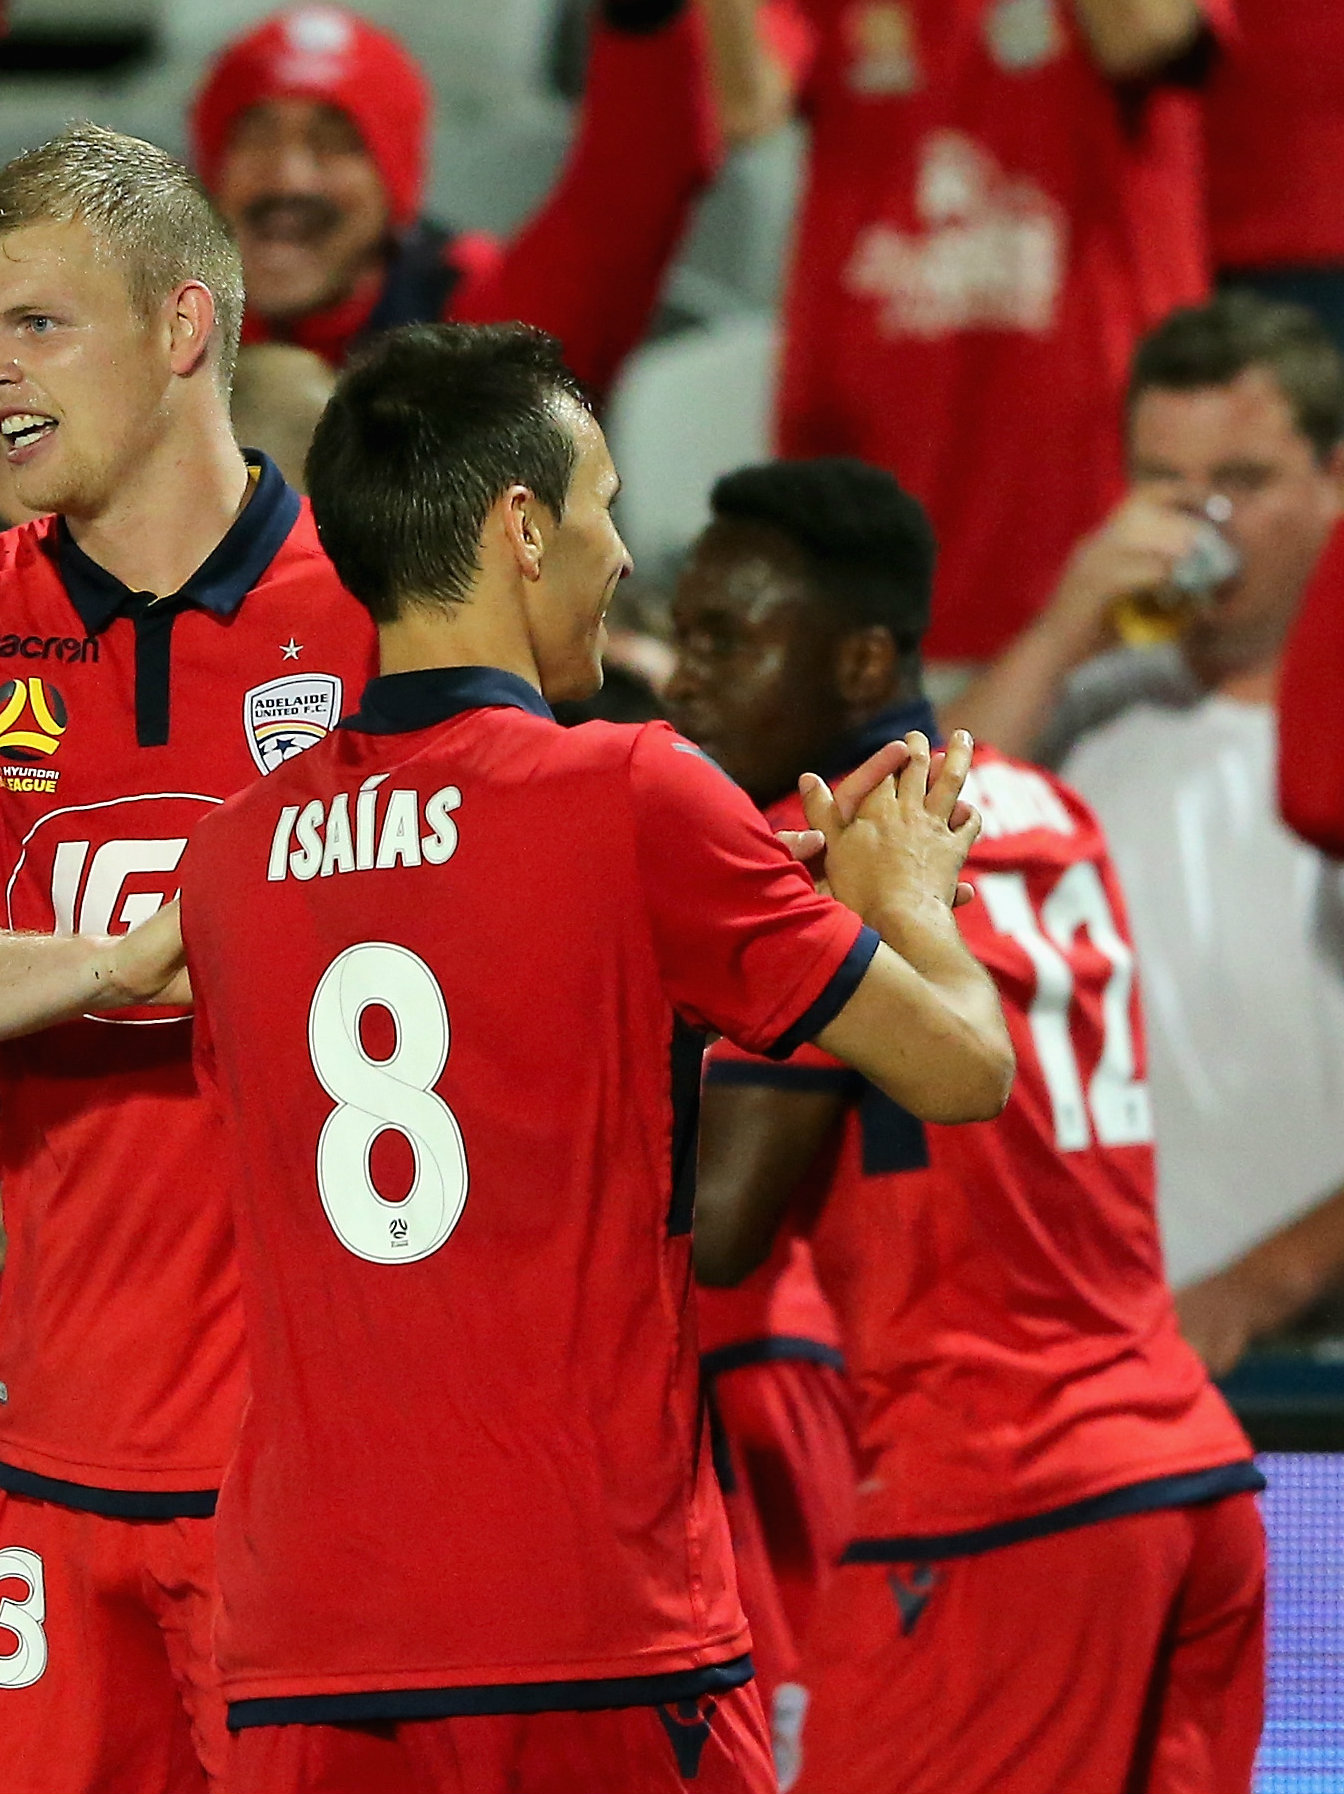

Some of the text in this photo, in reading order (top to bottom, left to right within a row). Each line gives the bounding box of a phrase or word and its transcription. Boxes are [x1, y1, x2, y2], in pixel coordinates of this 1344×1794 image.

[254, 693, 328, 709] ADELAIDE
[254, 704, 327, 718] UNITED F.C.
[3, 766, 60, 779] HYUNDAI
[267, 772, 462, 881] ISAÍAS
[52, 839, 188, 936] IG
[976, 860, 1154, 1151] 12
[308, 941, 470, 1265] 8
